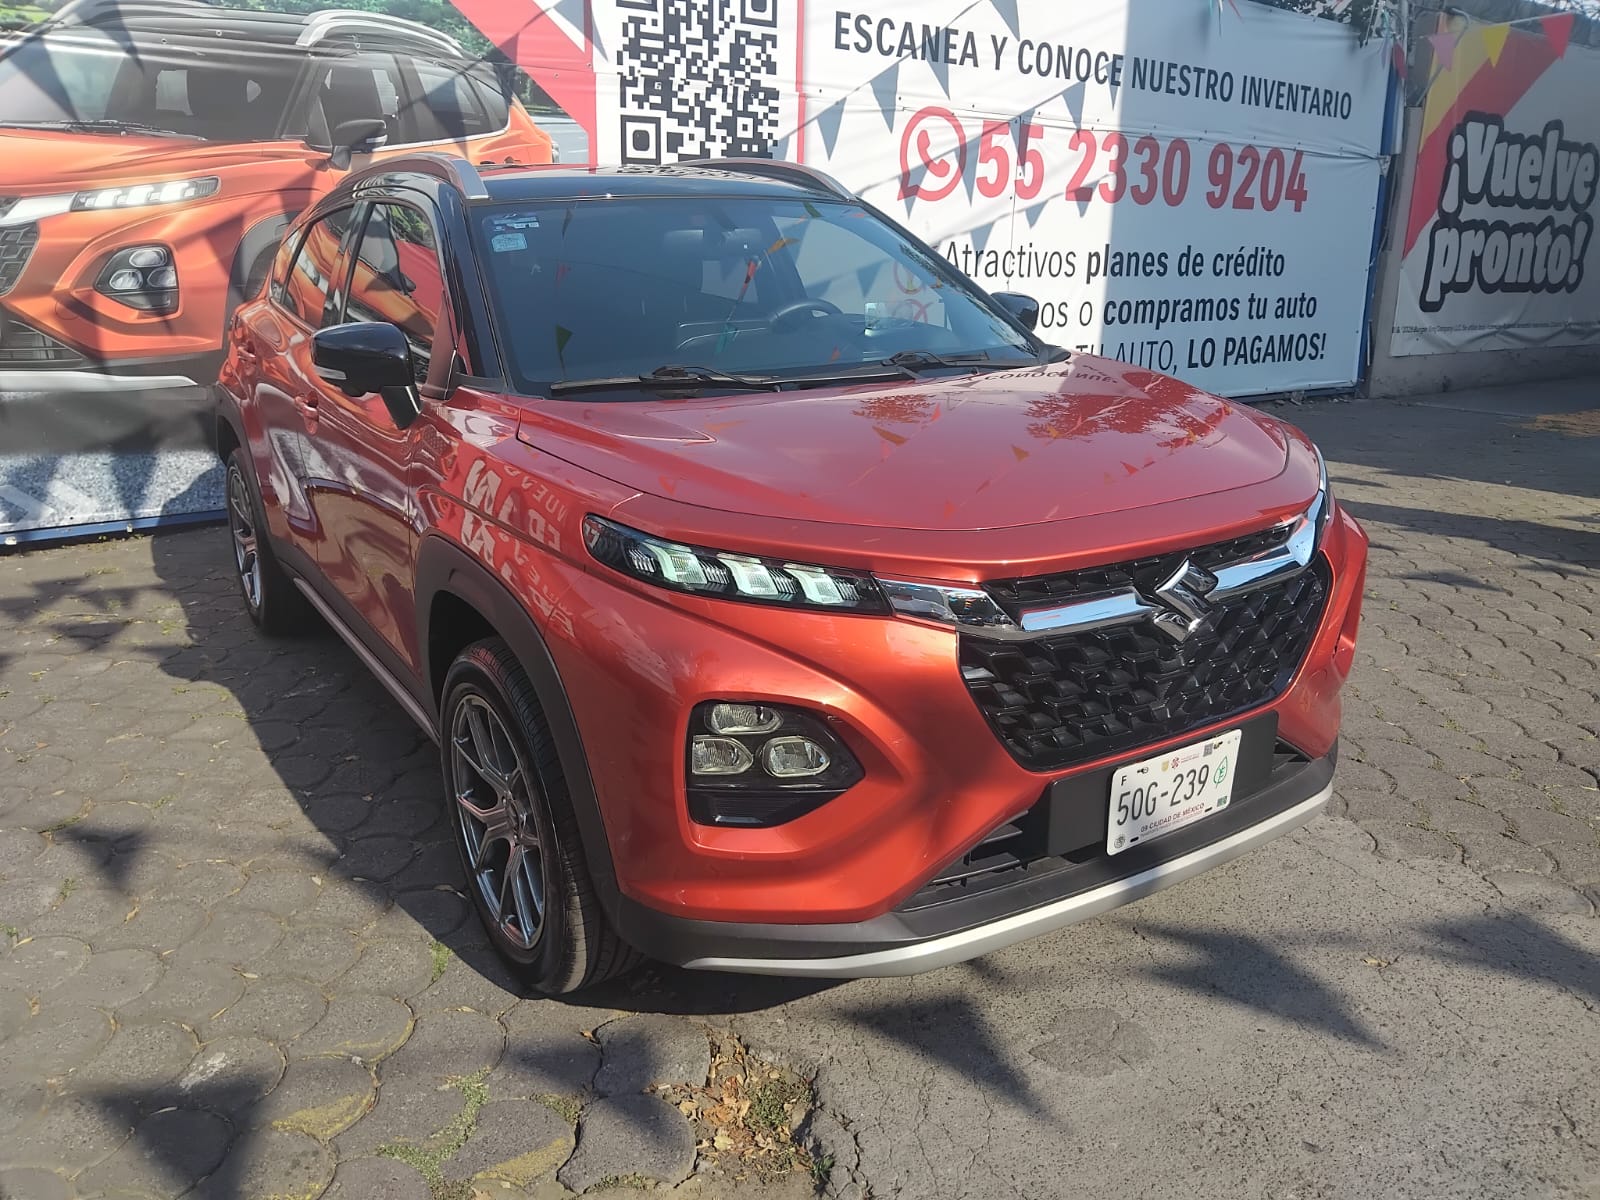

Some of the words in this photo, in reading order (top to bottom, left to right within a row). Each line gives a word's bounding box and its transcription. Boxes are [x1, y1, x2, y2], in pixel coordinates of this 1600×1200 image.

[835, 10, 979, 68] ESCANEA
[991, 34, 1008, 71] Y
[1018, 39, 1124, 87] CONOCE
[1132, 57, 1234, 102] NUESTRO
[1241, 75, 1352, 120] INVENTARIO
[976, 120, 1044, 200] 55
[1065, 130, 1191, 207] 2330
[1206, 143, 1308, 212] 9204
[1440, 114, 1599, 214] ¡Vuelve
[946, 241, 1076, 279] Atractivos
[1086, 243, 1168, 285] planes
[1178, 245, 1204, 278] de
[1213, 246, 1285, 278] crédito
[1422, 216, 1591, 308] pronto!
[1079, 301, 1093, 327] o
[1103, 295, 1240, 330] compramos
[1248, 293, 1268, 320] tu
[1275, 291, 1317, 319] auto
[1187, 338, 1216, 368] LO
[1223, 333, 1327, 367] PAGAMOS!
[1117, 764, 1210, 826] 50G-239
[1120, 775, 1128, 786] F
